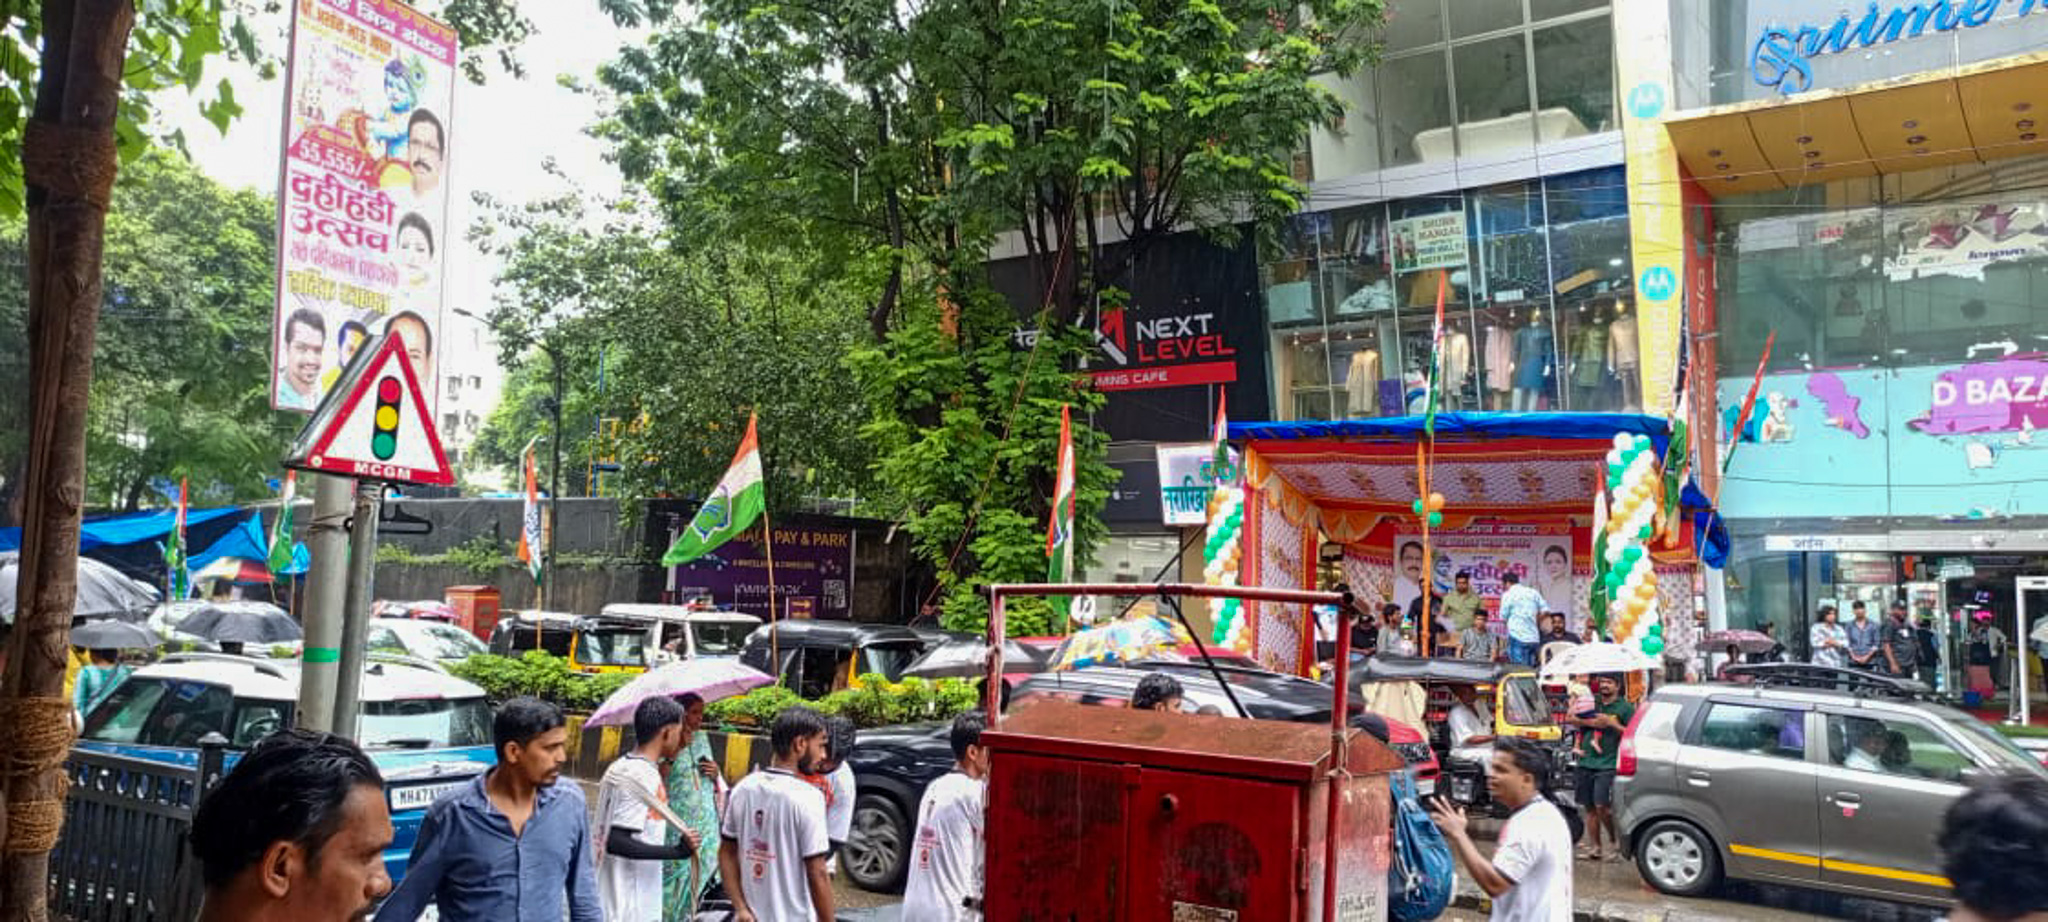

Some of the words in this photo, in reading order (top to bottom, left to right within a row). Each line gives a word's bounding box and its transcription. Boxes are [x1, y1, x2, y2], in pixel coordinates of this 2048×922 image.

[290, 168, 396, 228] दहीहंडी
[291, 205, 389, 253] उत्सव
[1136, 313, 1214, 341] NEXT
[1137, 334, 1237, 362] LEVEL
[1132, 368, 1167, 384] CAFE
[354, 463, 411, 480] MCGM
[774, 530, 798, 545] PAY
[801, 532, 810, 546] &
[812, 533, 848, 548] PARK
